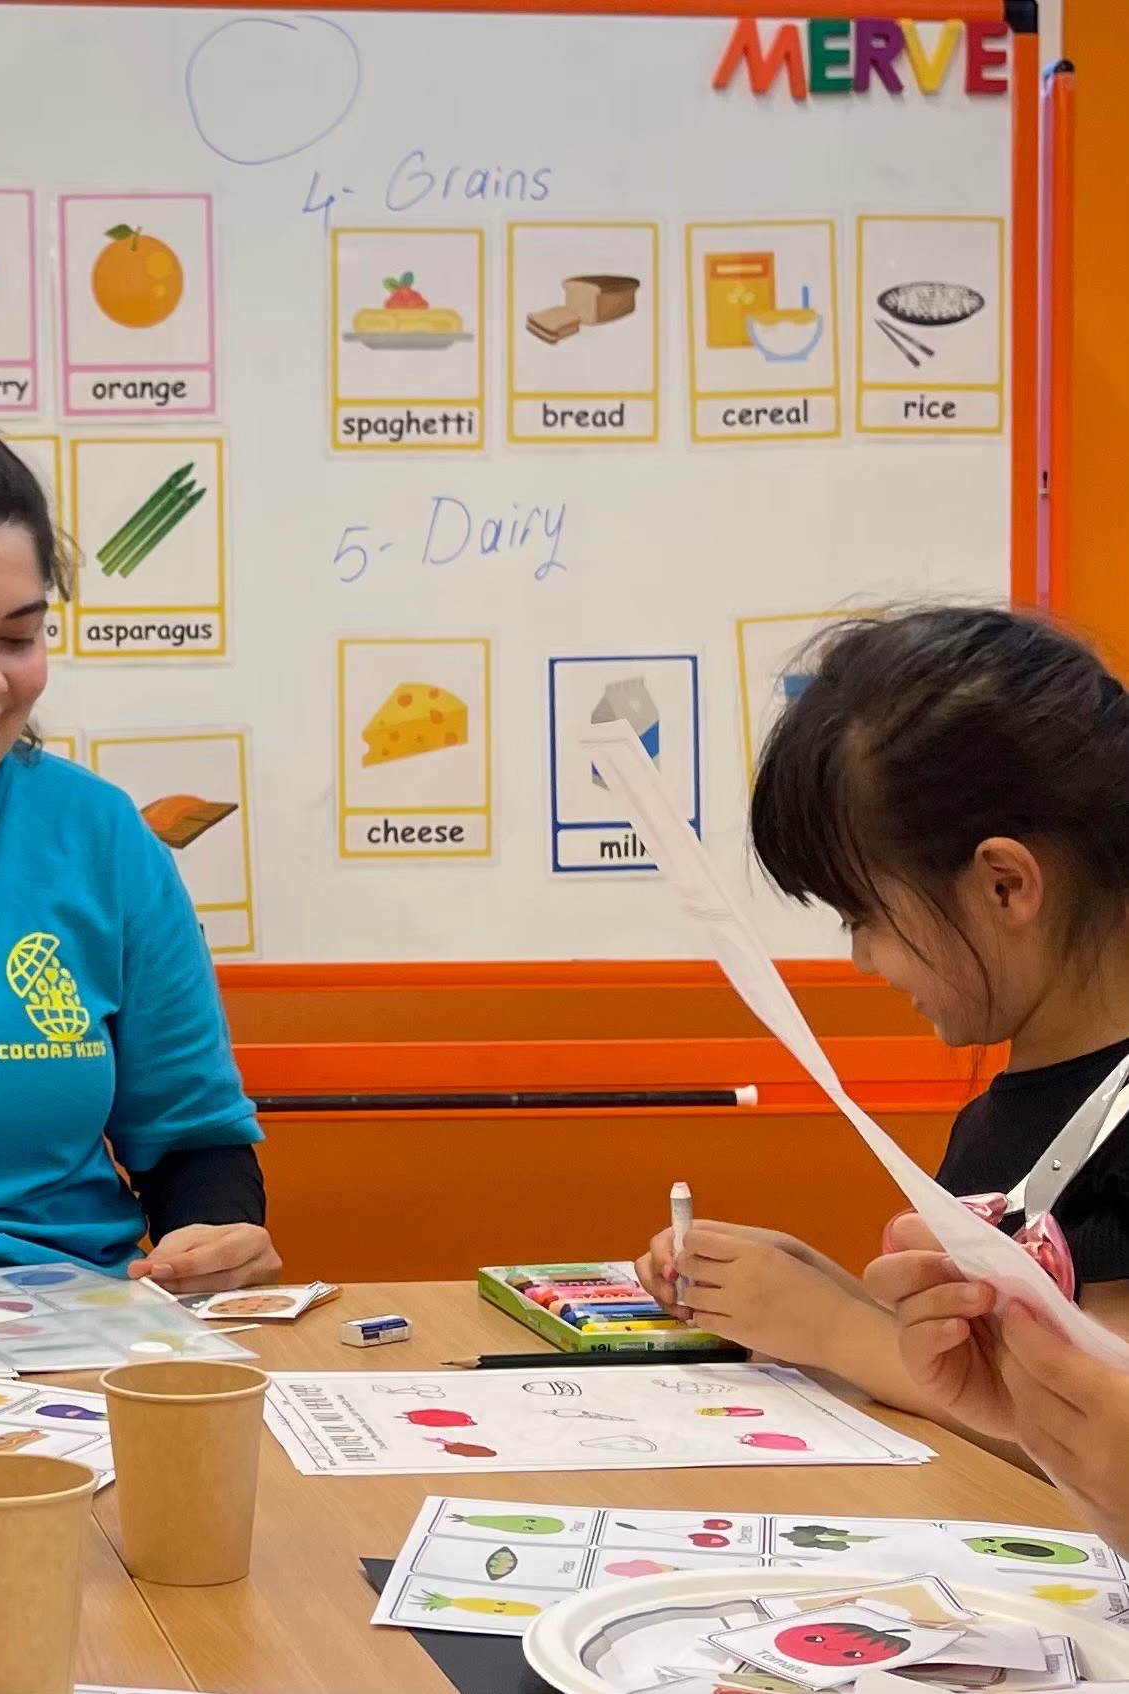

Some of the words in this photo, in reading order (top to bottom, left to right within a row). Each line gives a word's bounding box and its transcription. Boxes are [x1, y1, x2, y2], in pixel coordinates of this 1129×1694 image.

[713, 17, 1008, 101] MERVE
[384, 151, 551, 211] Grains
[91, 376, 188, 405] orange
[541, 402, 625, 429] bread
[722, 398, 809, 427] cereal
[903, 396, 958, 421] rice
[342, 411, 474, 443] spaghetti
[421, 494, 568, 582] Dairy
[86, 620, 213, 648] asparagus
[366, 820, 466, 846] cheese
[75, 1041, 106, 1057] KIDS
[754, 1649, 810, 1677] Tomato
